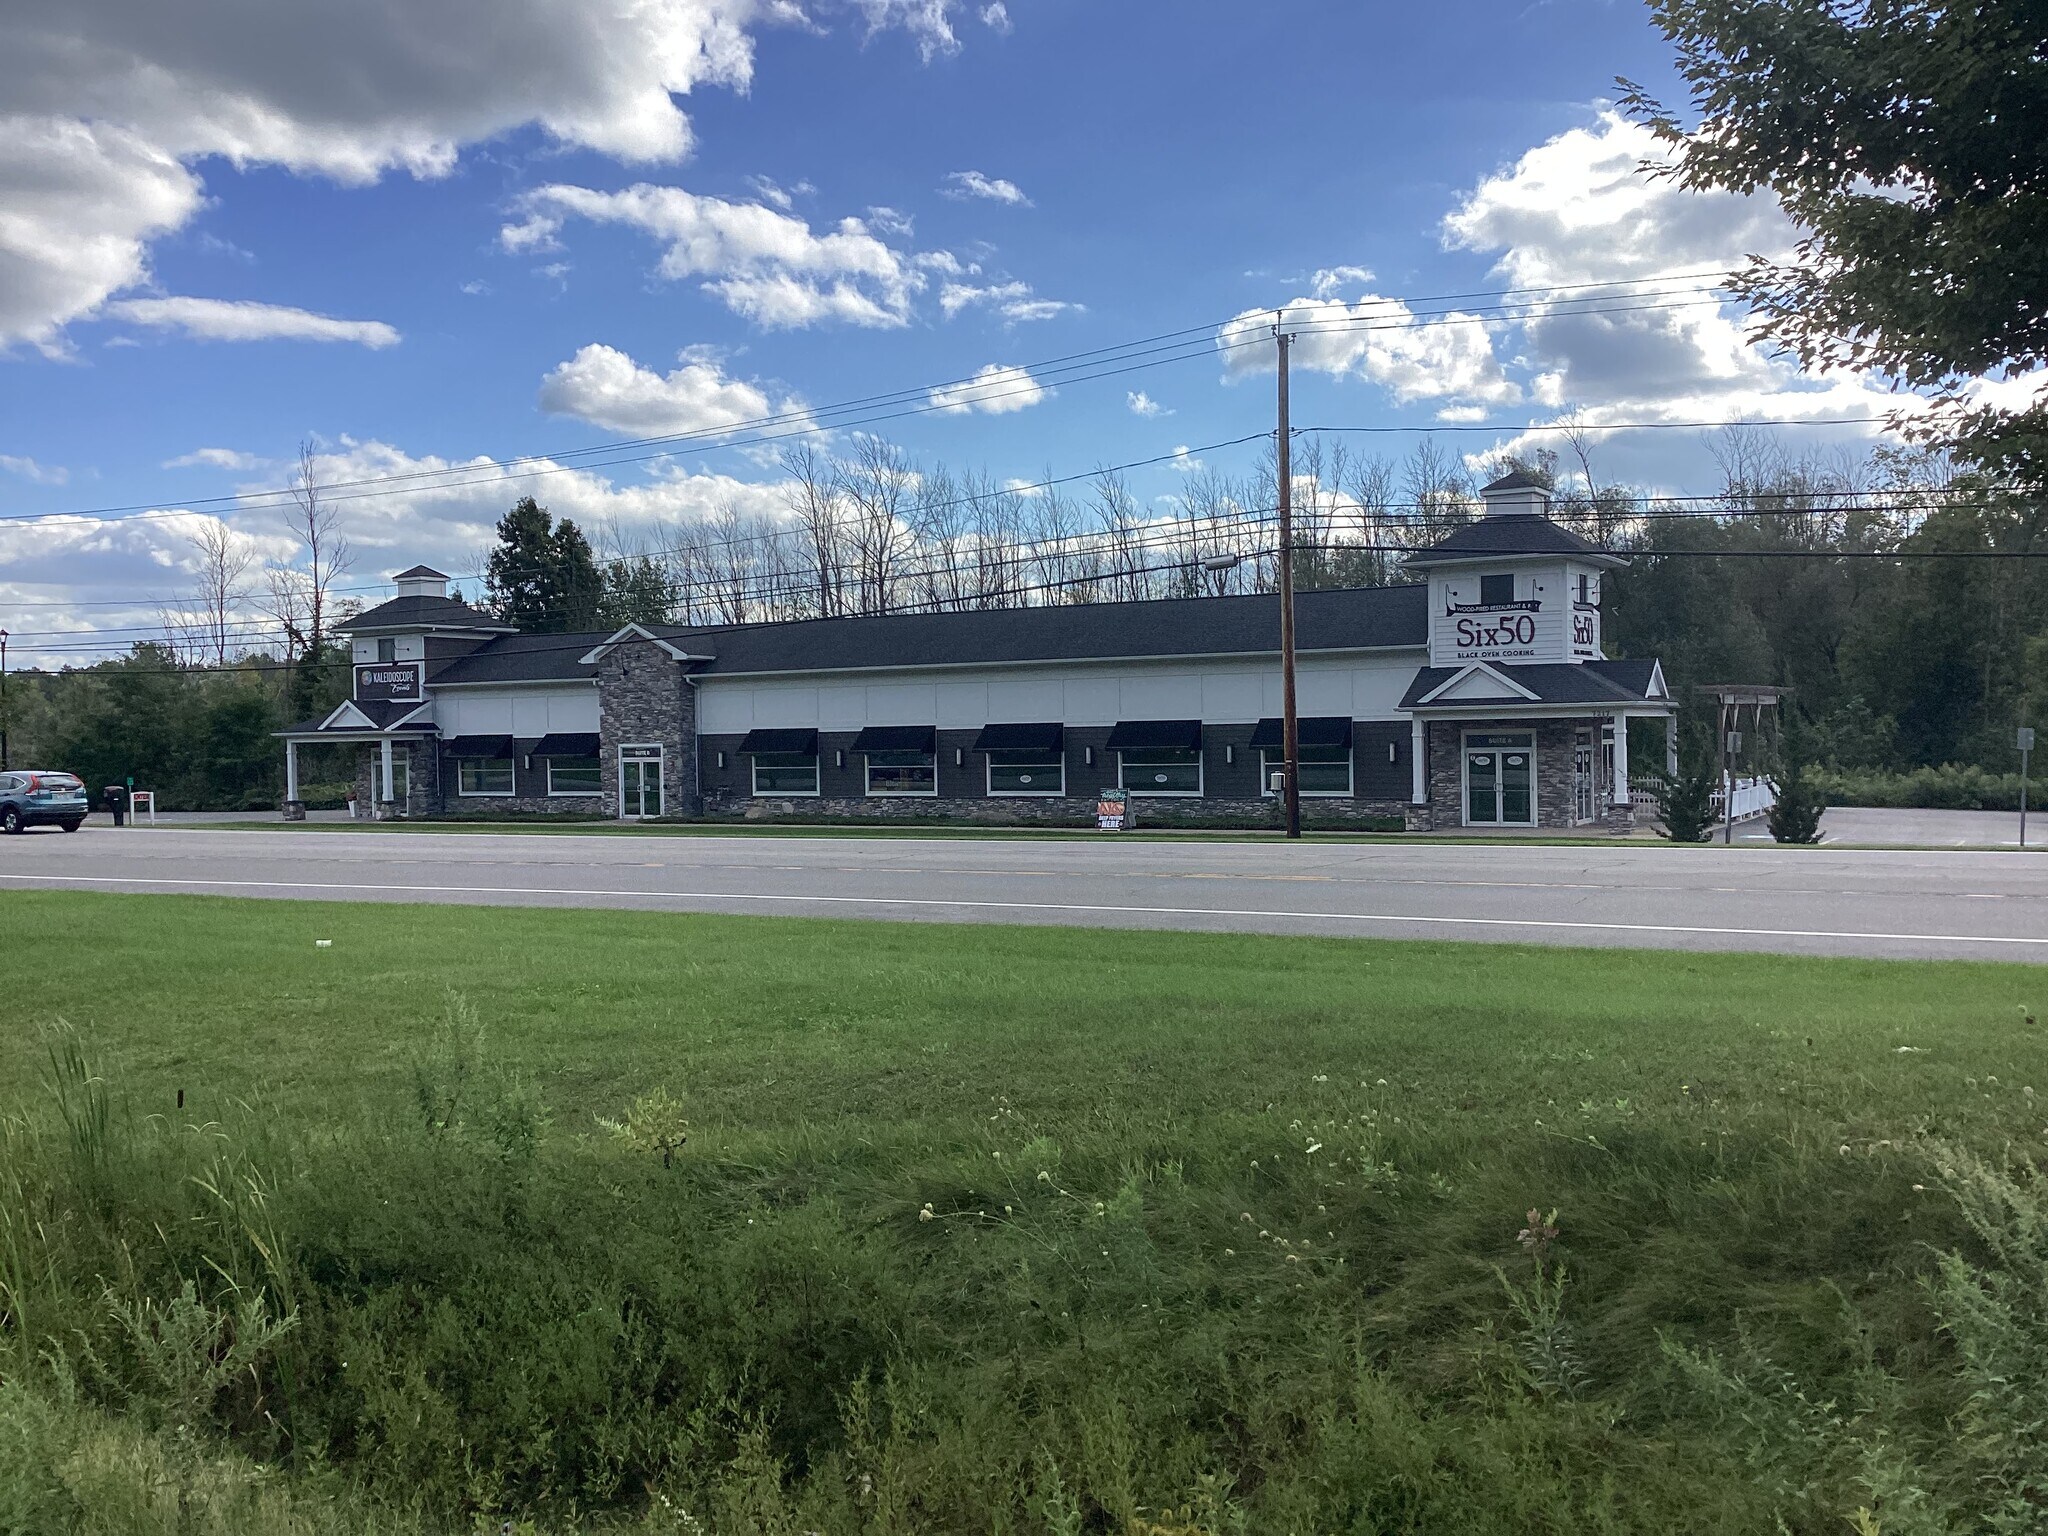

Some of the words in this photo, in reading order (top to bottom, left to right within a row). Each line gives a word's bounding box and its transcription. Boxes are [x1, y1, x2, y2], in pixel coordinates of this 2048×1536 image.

[1490, 603, 1521, 611] RESTAURANT
[1457, 615, 1535, 647] Six50
[1457, 651, 1479, 659] BLACK
[1503, 649, 1535, 657] COOKING
[373, 671, 414, 683] KALEIDOSCOPE
[1101, 820, 1120, 828] HERE
